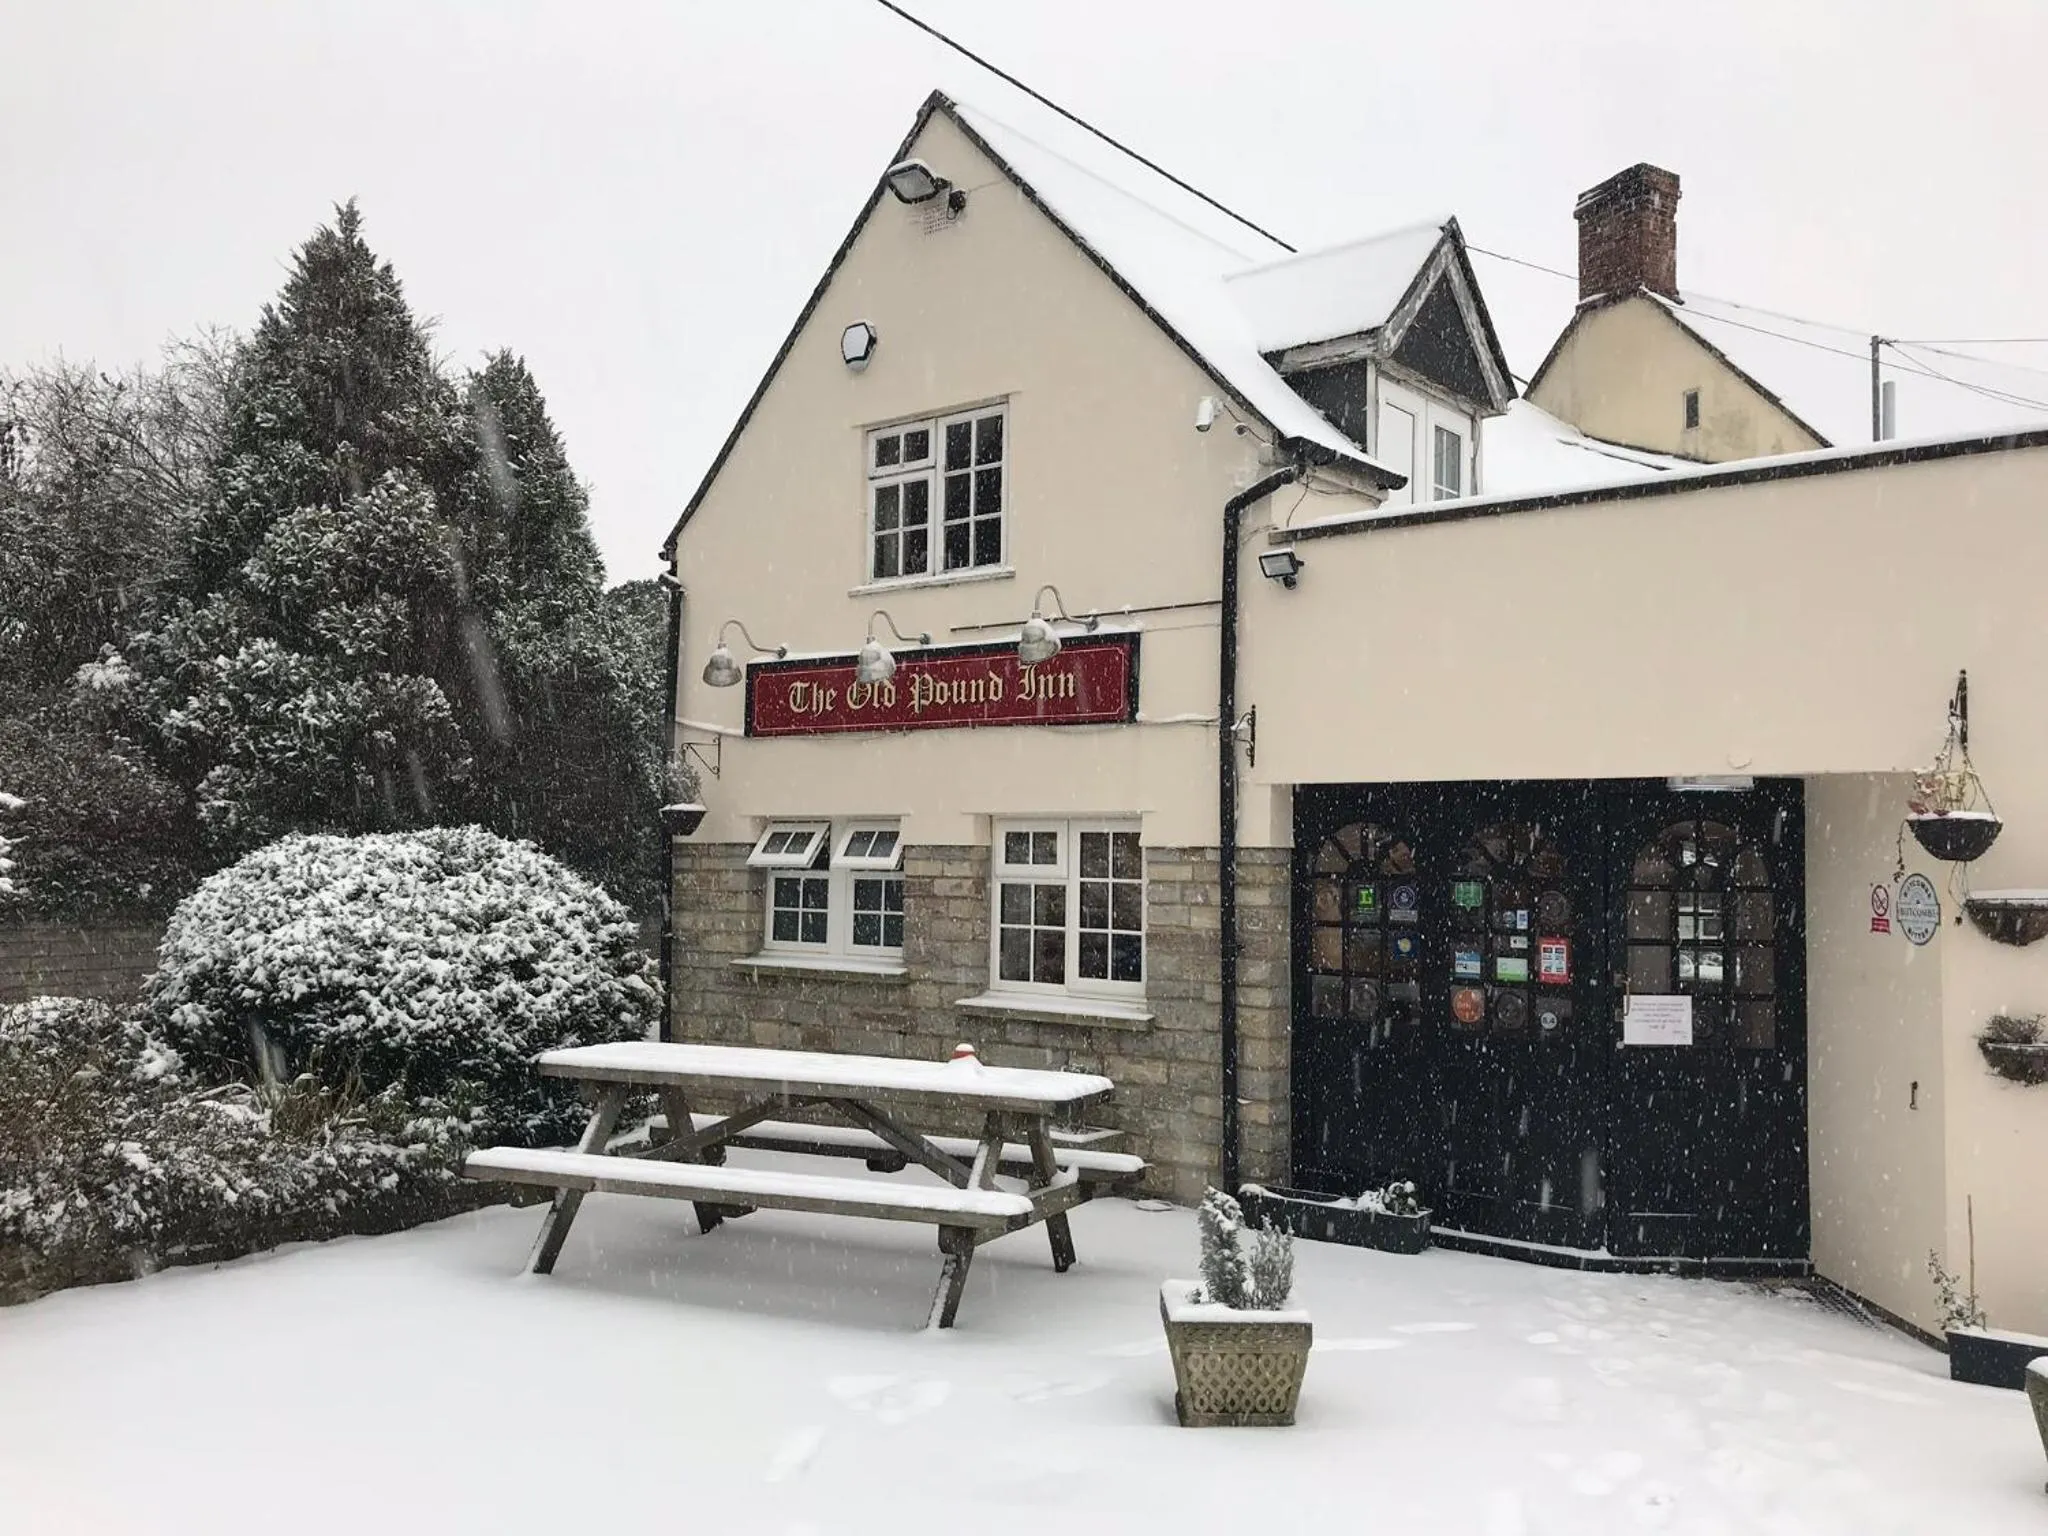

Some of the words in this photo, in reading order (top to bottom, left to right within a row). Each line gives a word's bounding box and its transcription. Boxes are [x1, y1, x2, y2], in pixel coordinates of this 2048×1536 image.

[788, 680, 838, 717] The
[847, 679, 896, 710] Old
[906, 670, 1003, 714] Pound
[1016, 664, 1076, 701] Inn
